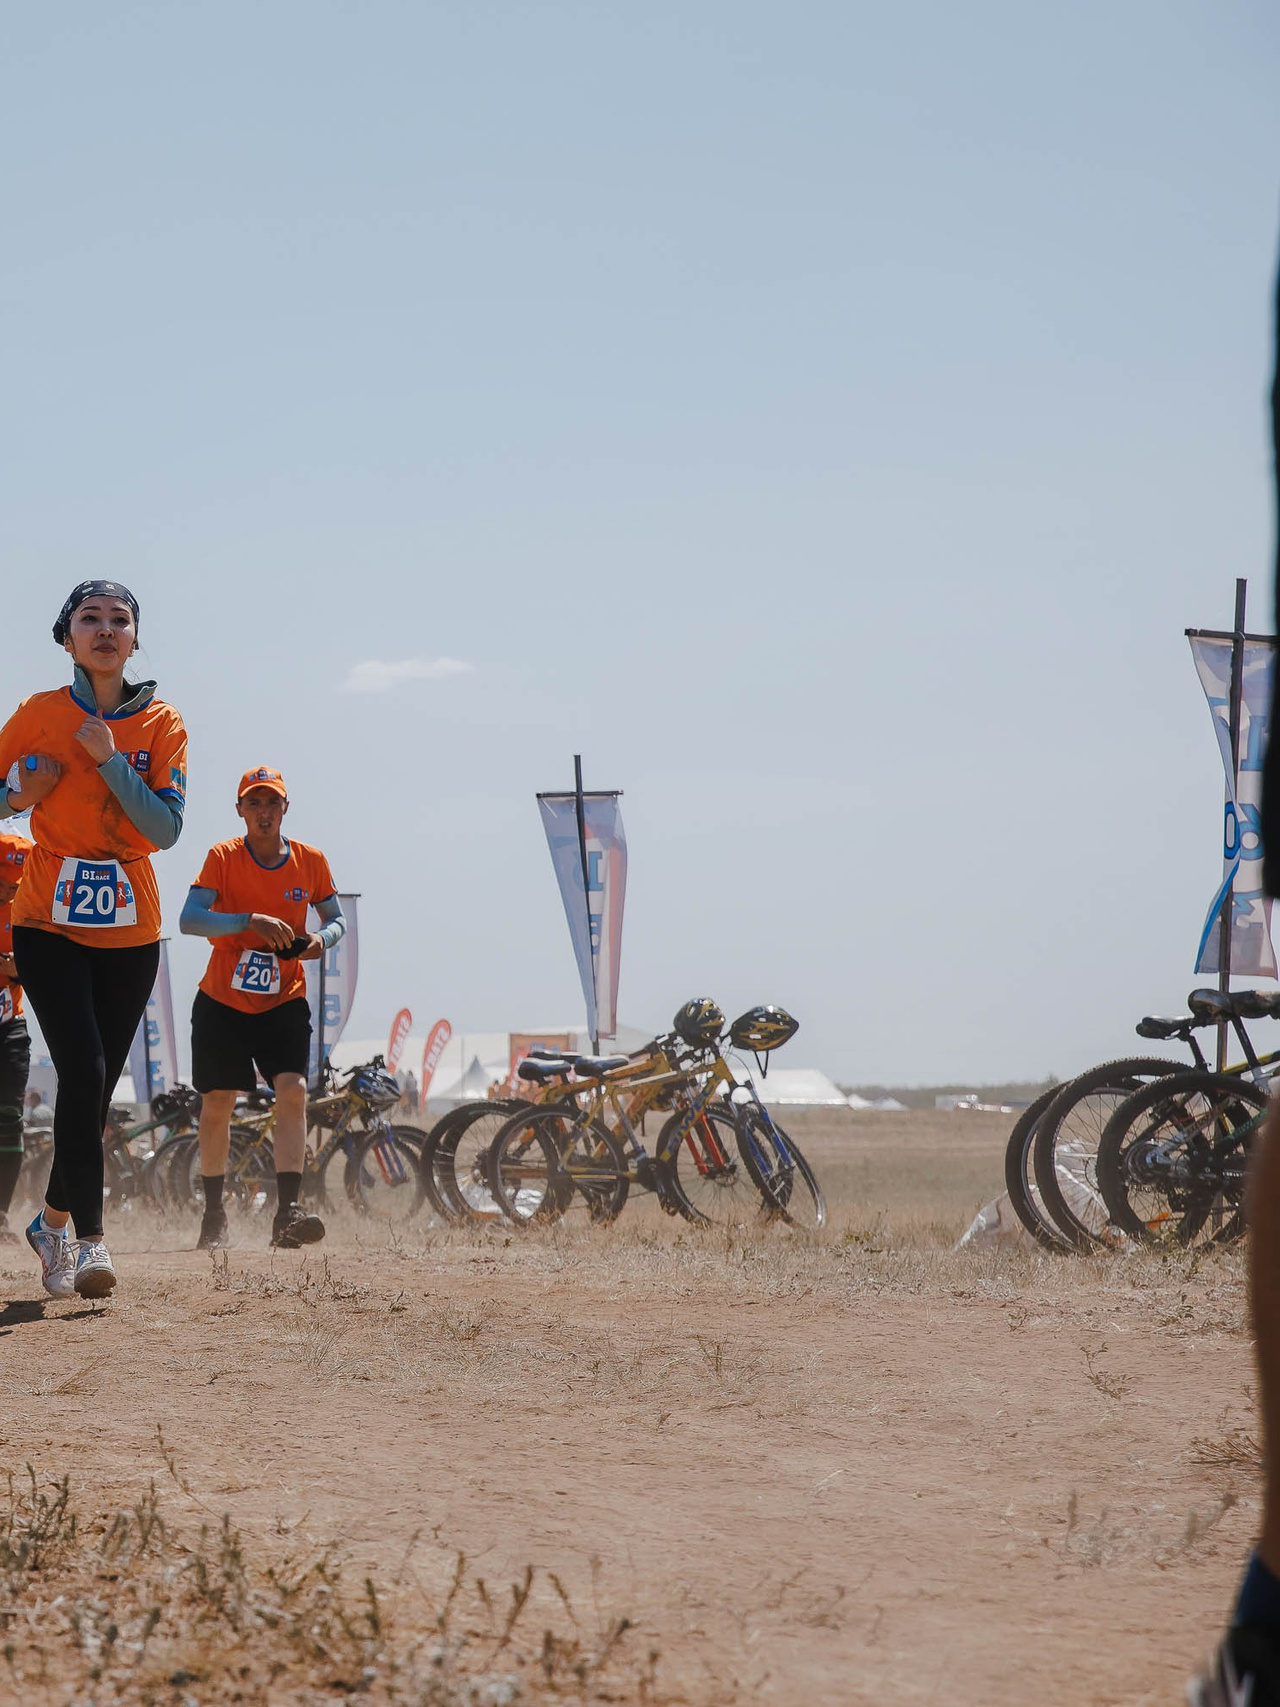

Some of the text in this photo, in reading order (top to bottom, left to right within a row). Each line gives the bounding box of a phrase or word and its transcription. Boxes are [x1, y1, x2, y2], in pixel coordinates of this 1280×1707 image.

[81, 869, 96, 881] BI
[74, 884, 116, 916] 20
[245, 966, 272, 987] 20
